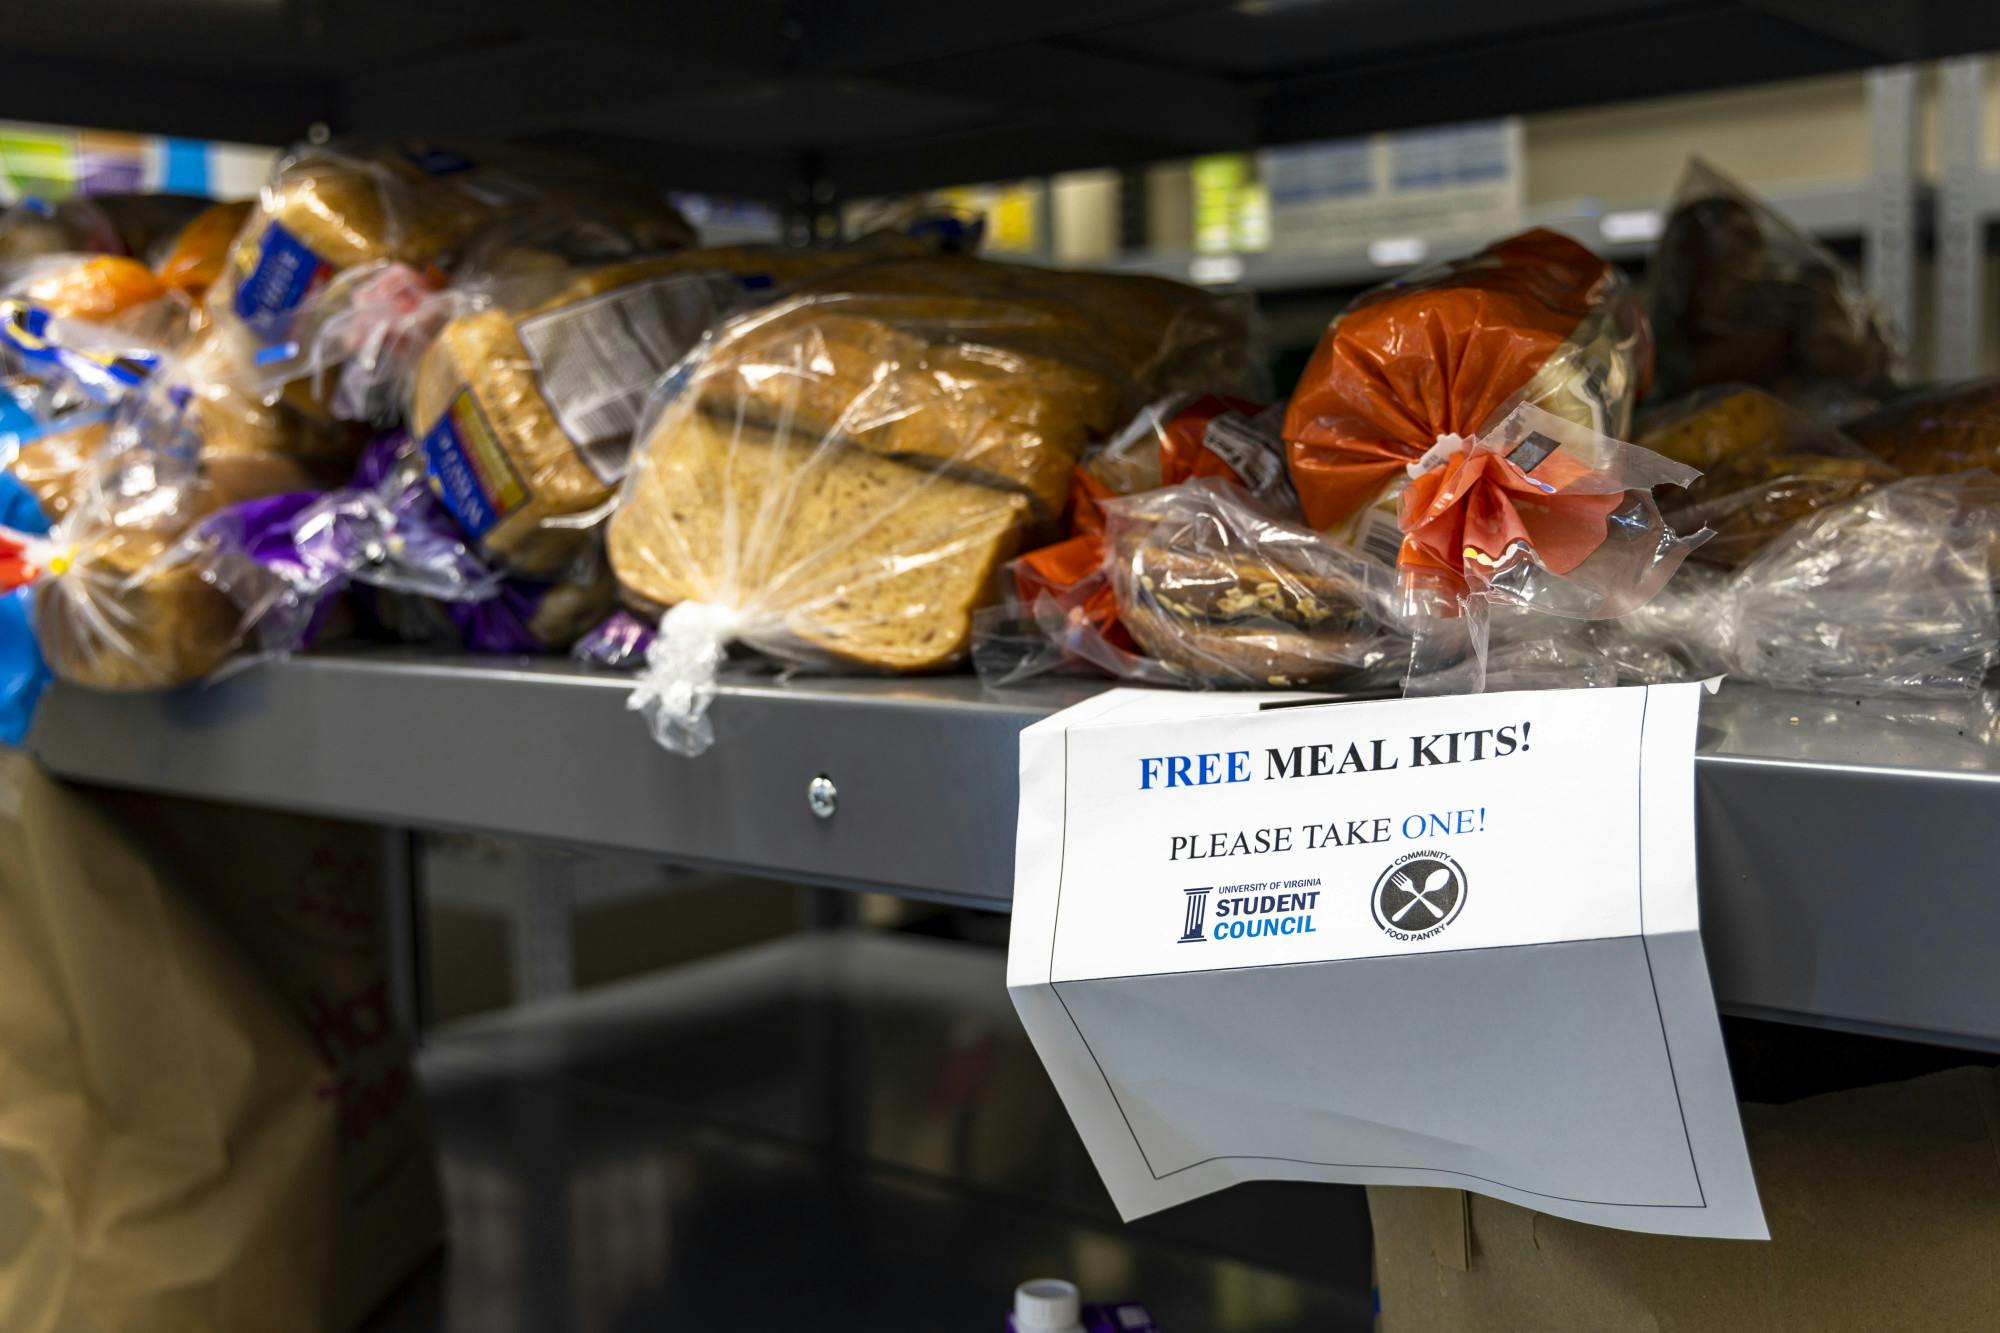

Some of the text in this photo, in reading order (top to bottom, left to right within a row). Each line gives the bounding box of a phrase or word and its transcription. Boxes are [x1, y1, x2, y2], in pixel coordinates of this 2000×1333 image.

[1138, 721, 1531, 790] FREE MEAL KITS!
[1169, 807, 1486, 861] PLEASE TAKE ONE!
[1394, 850, 1451, 866] COMMUNITY
[1218, 878, 1321, 894] UNIVERSITY OF VIRGINIA
[1215, 892, 1320, 917] STUDENT
[1213, 915, 1316, 940] COUNCIL
[1385, 923, 1445, 941] FOOD PANTRY
